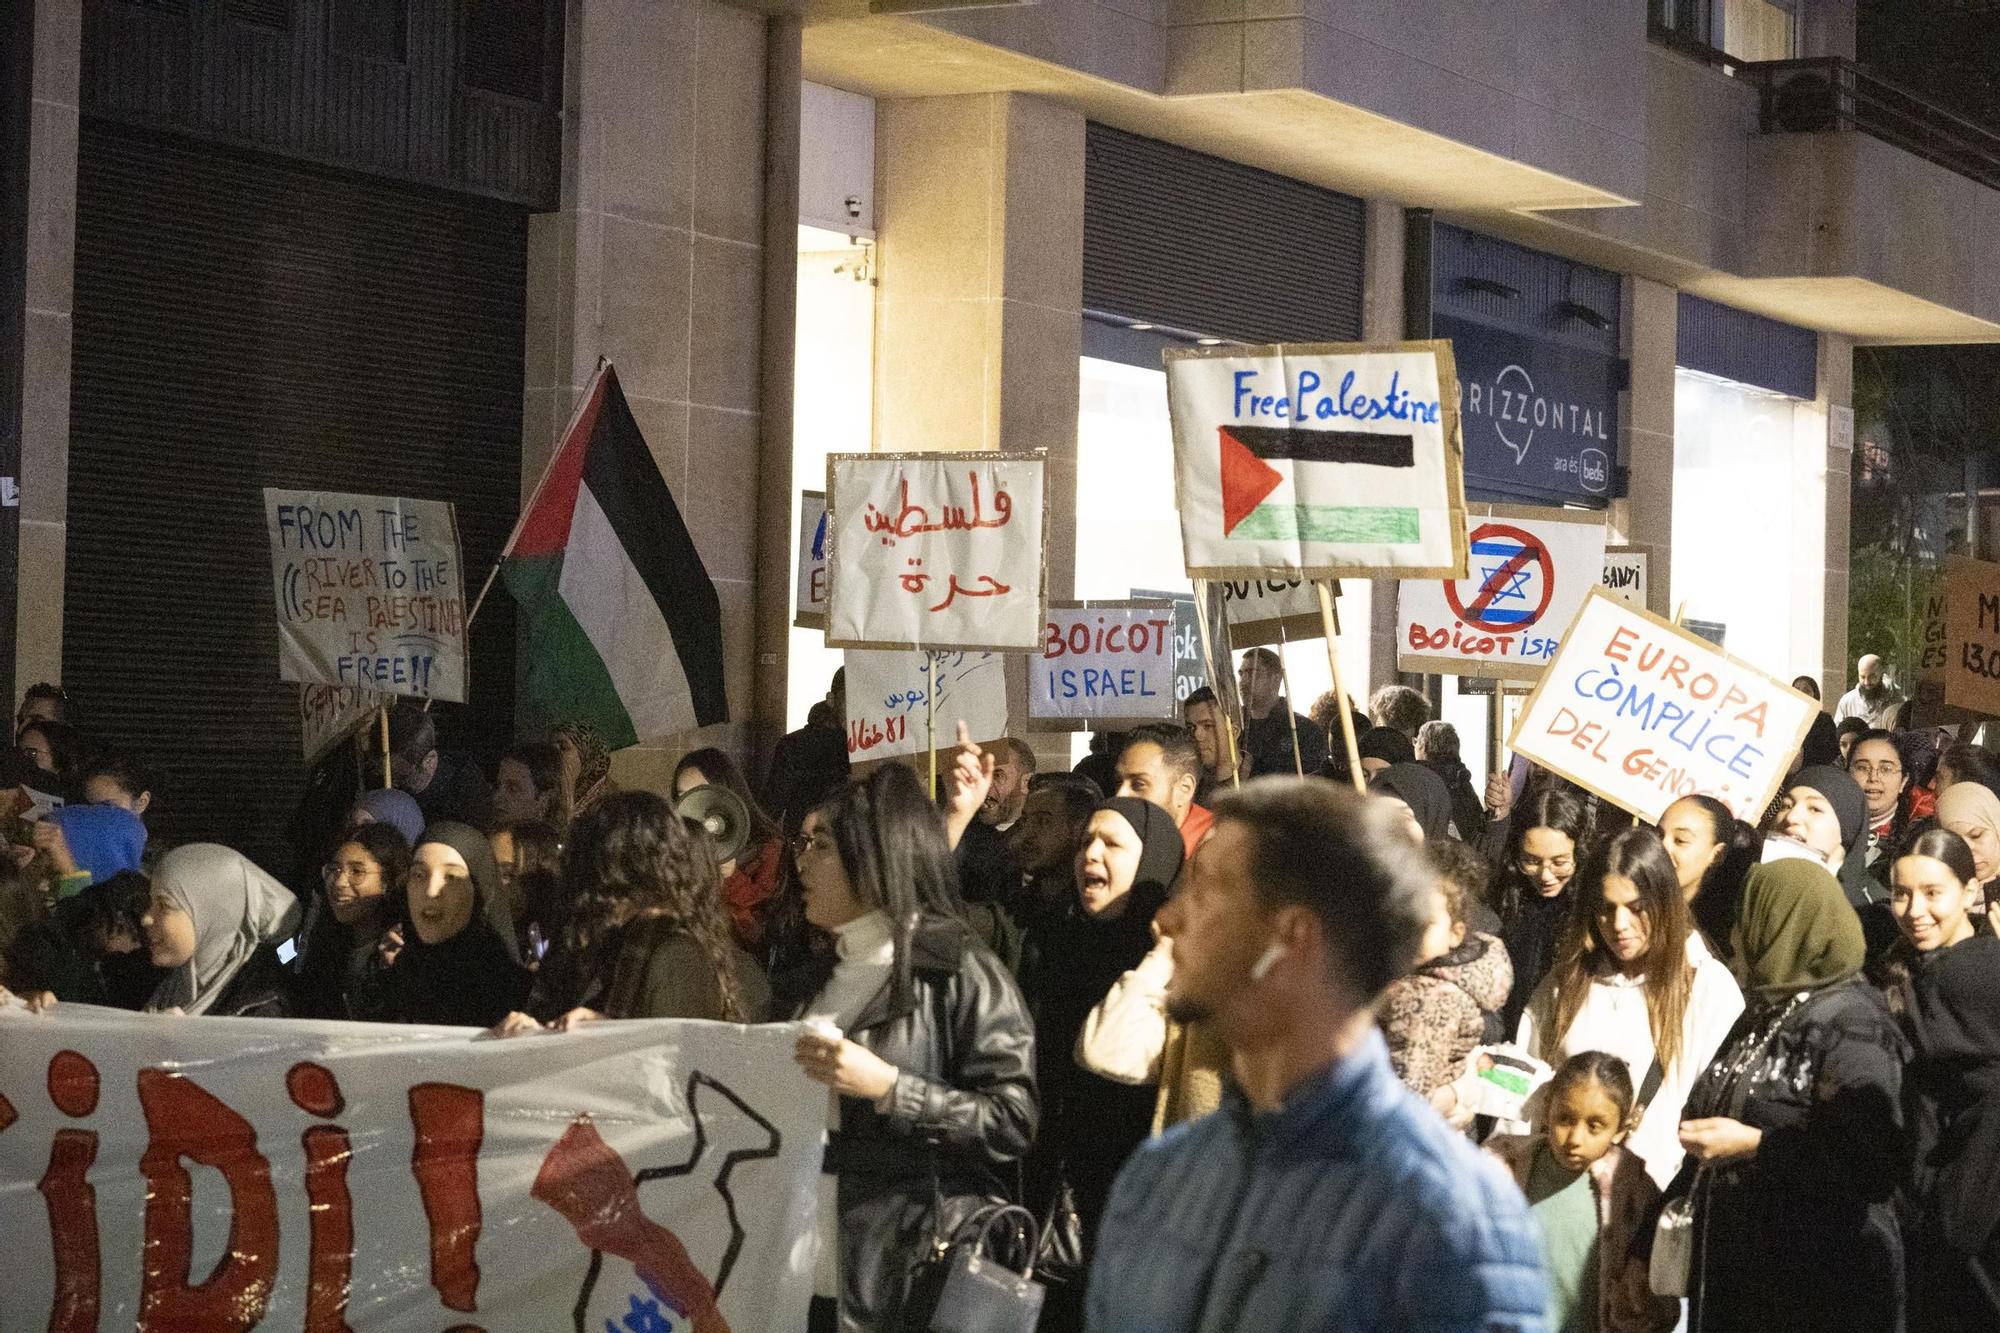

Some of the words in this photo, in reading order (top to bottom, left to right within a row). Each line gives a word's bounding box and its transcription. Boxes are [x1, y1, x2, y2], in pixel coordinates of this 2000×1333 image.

[1233, 371, 1290, 418] Free
[1295, 370, 1440, 424] Palestine
[1457, 379, 1608, 440] RIZZONTAL
[1554, 457, 1568, 472] ara
[277, 505, 363, 552] FROM
[376, 510, 420, 552] THE
[865, 471, 1012, 547] فلسطين
[304, 557, 378, 592] RIVER
[379, 561, 406, 590] TO
[411, 560, 449, 592] THE
[899, 559, 1011, 612] حرة
[301, 597, 346, 623] SEA
[349, 631, 378, 655] IS
[337, 656, 433, 697] FREE!!
[1050, 668, 1156, 699] ISRAEL
[1604, 626, 1768, 738] EUROPA
[1547, 707, 1612, 763] DEL
[0, 1049, 485, 1333] iDi!
